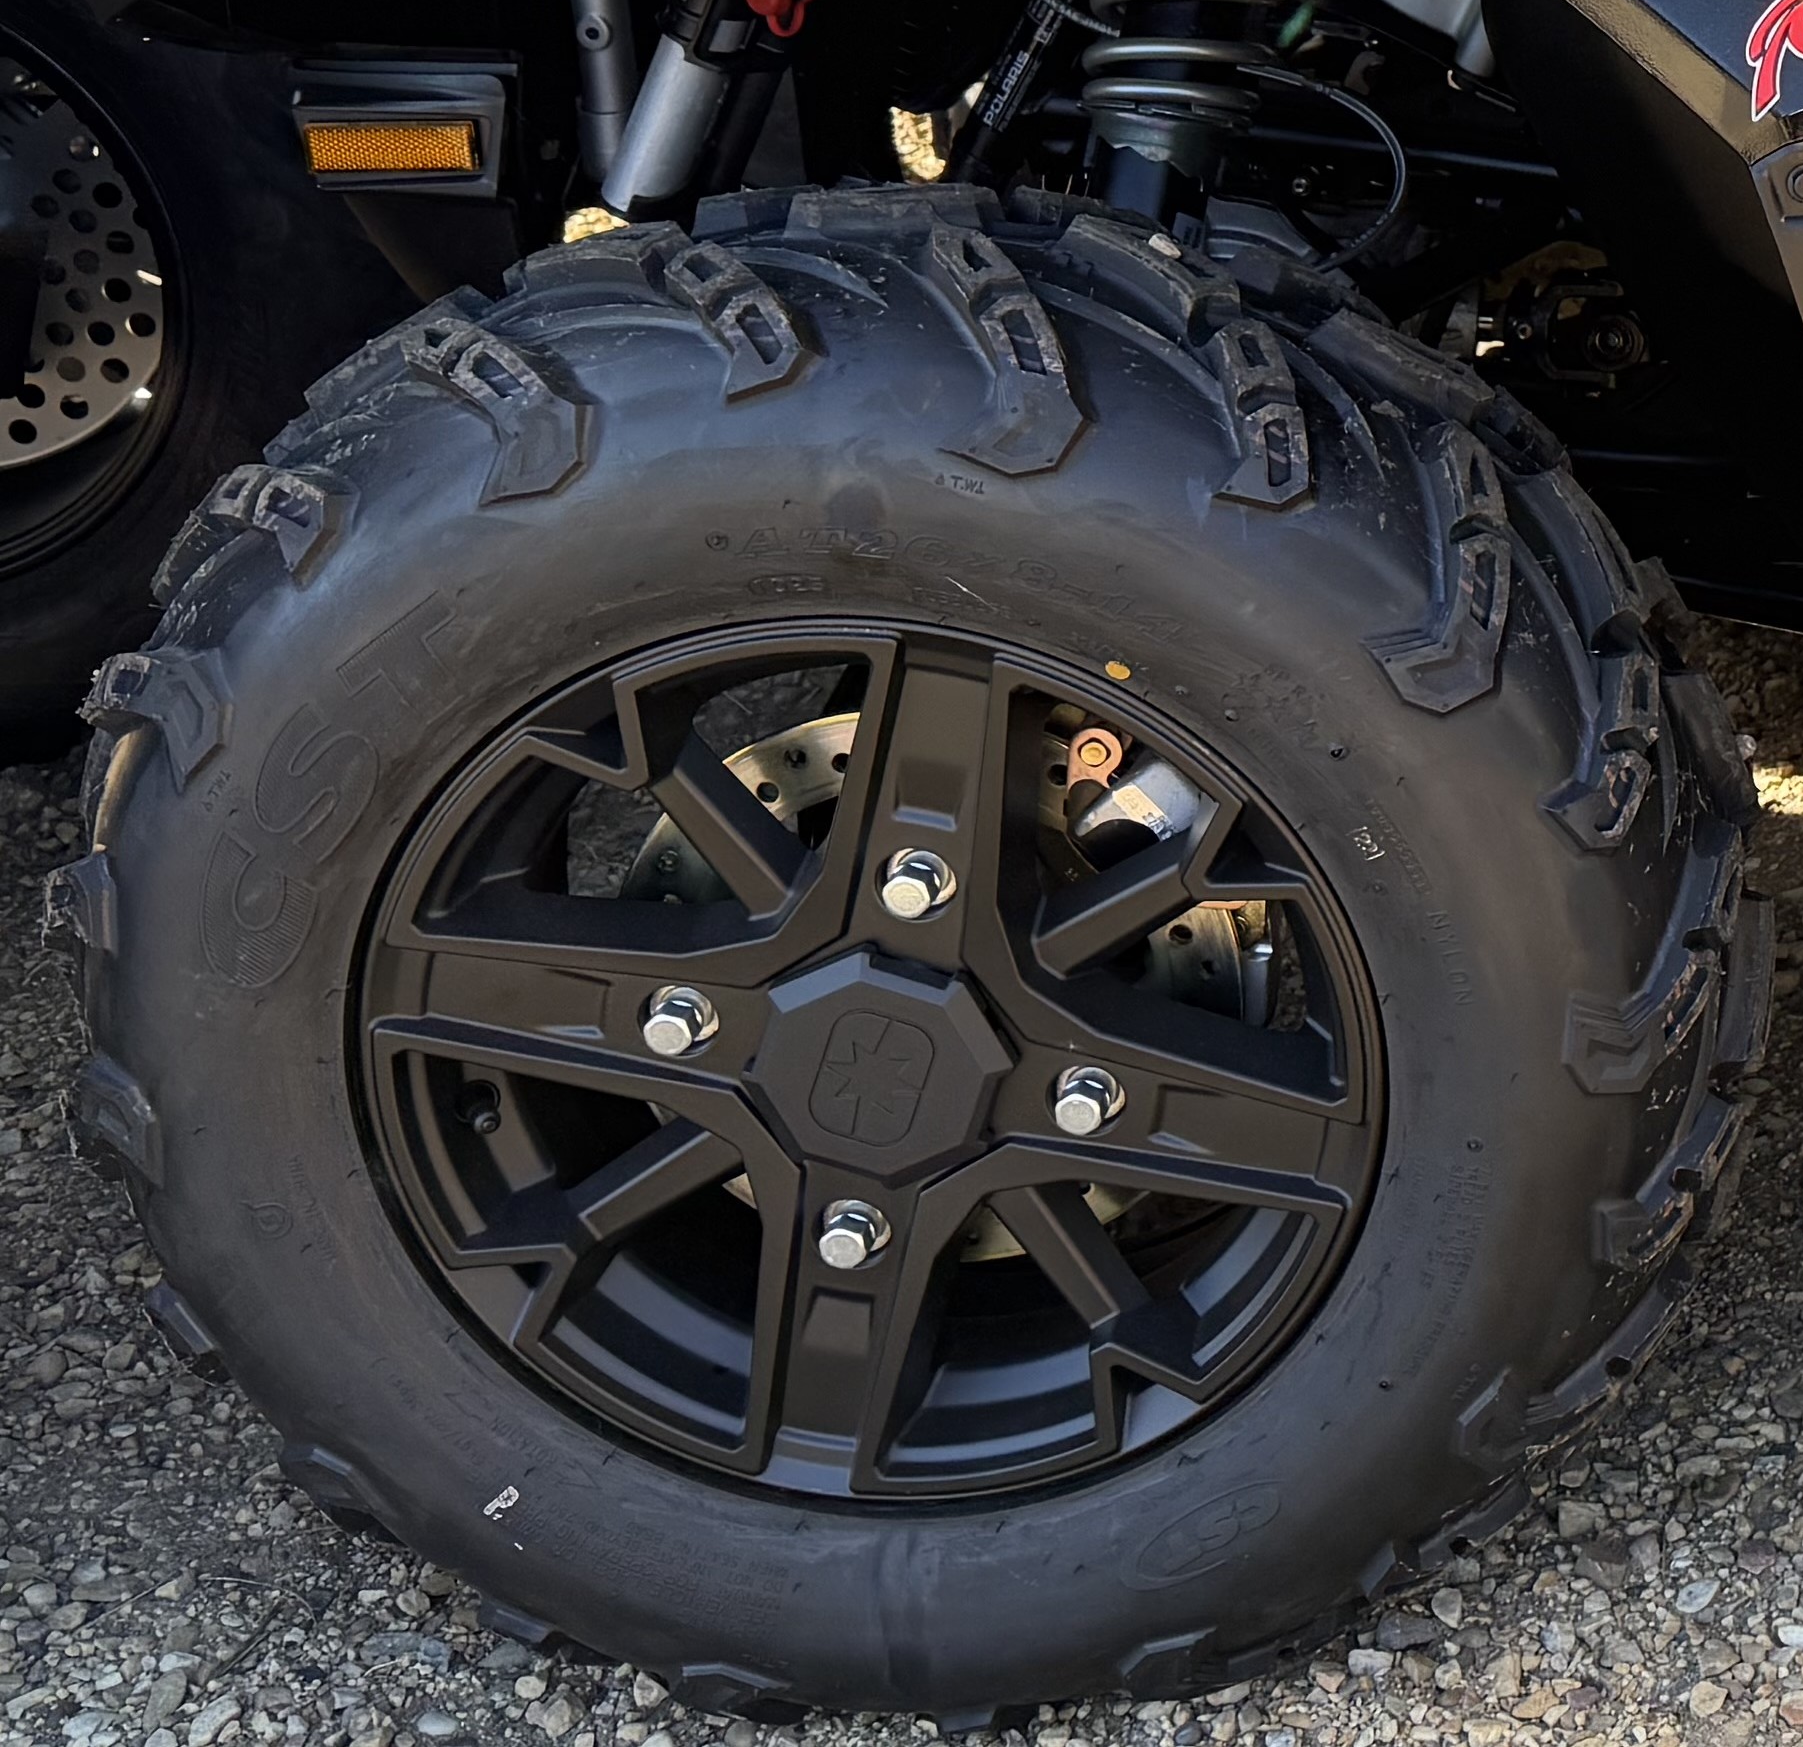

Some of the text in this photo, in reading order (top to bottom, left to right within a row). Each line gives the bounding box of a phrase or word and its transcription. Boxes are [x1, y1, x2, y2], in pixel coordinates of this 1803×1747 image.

[983, 50, 1030, 127] POLARIS
[200, 589, 464, 990] CST
[1427, 908, 1473, 1006] NYLON
